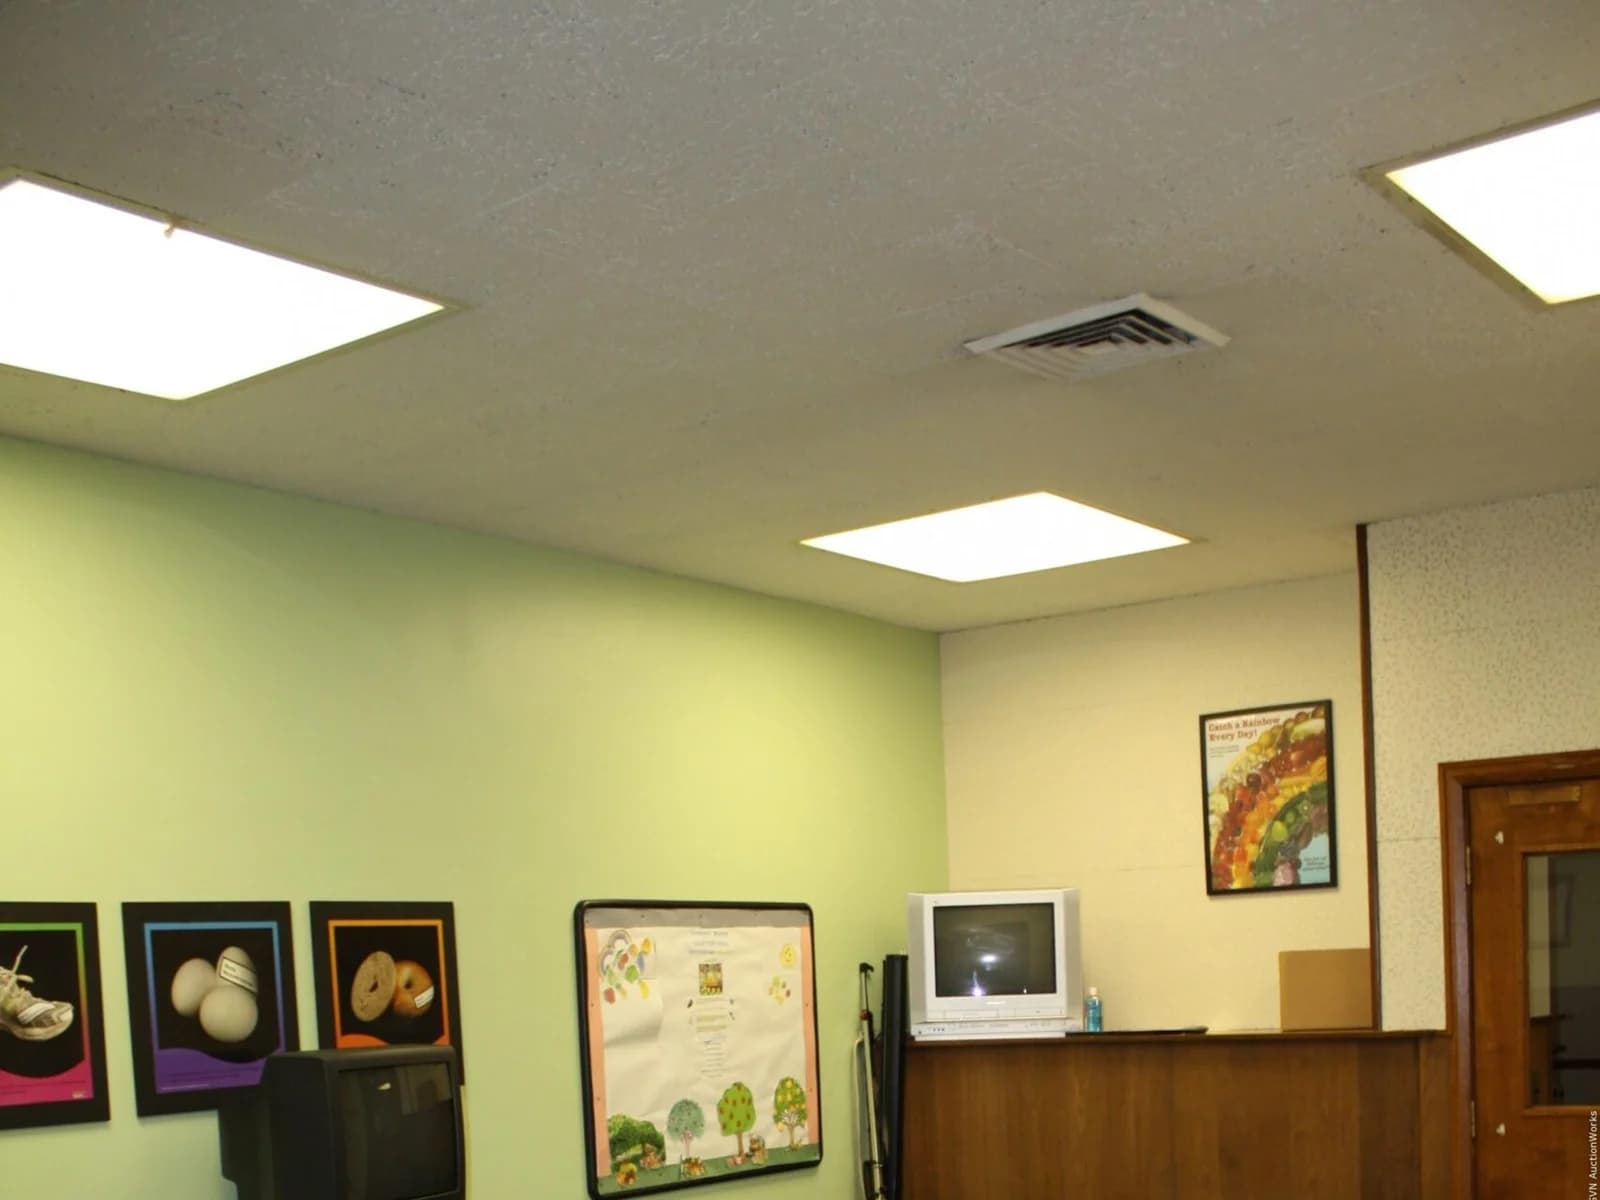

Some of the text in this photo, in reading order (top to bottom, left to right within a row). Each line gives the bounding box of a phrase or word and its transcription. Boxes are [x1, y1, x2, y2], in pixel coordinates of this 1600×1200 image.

[1208, 722, 1232, 731] Catch
[1242, 717, 1280, 728] Rainbow
[1210, 730, 1257, 742] Every Day!
